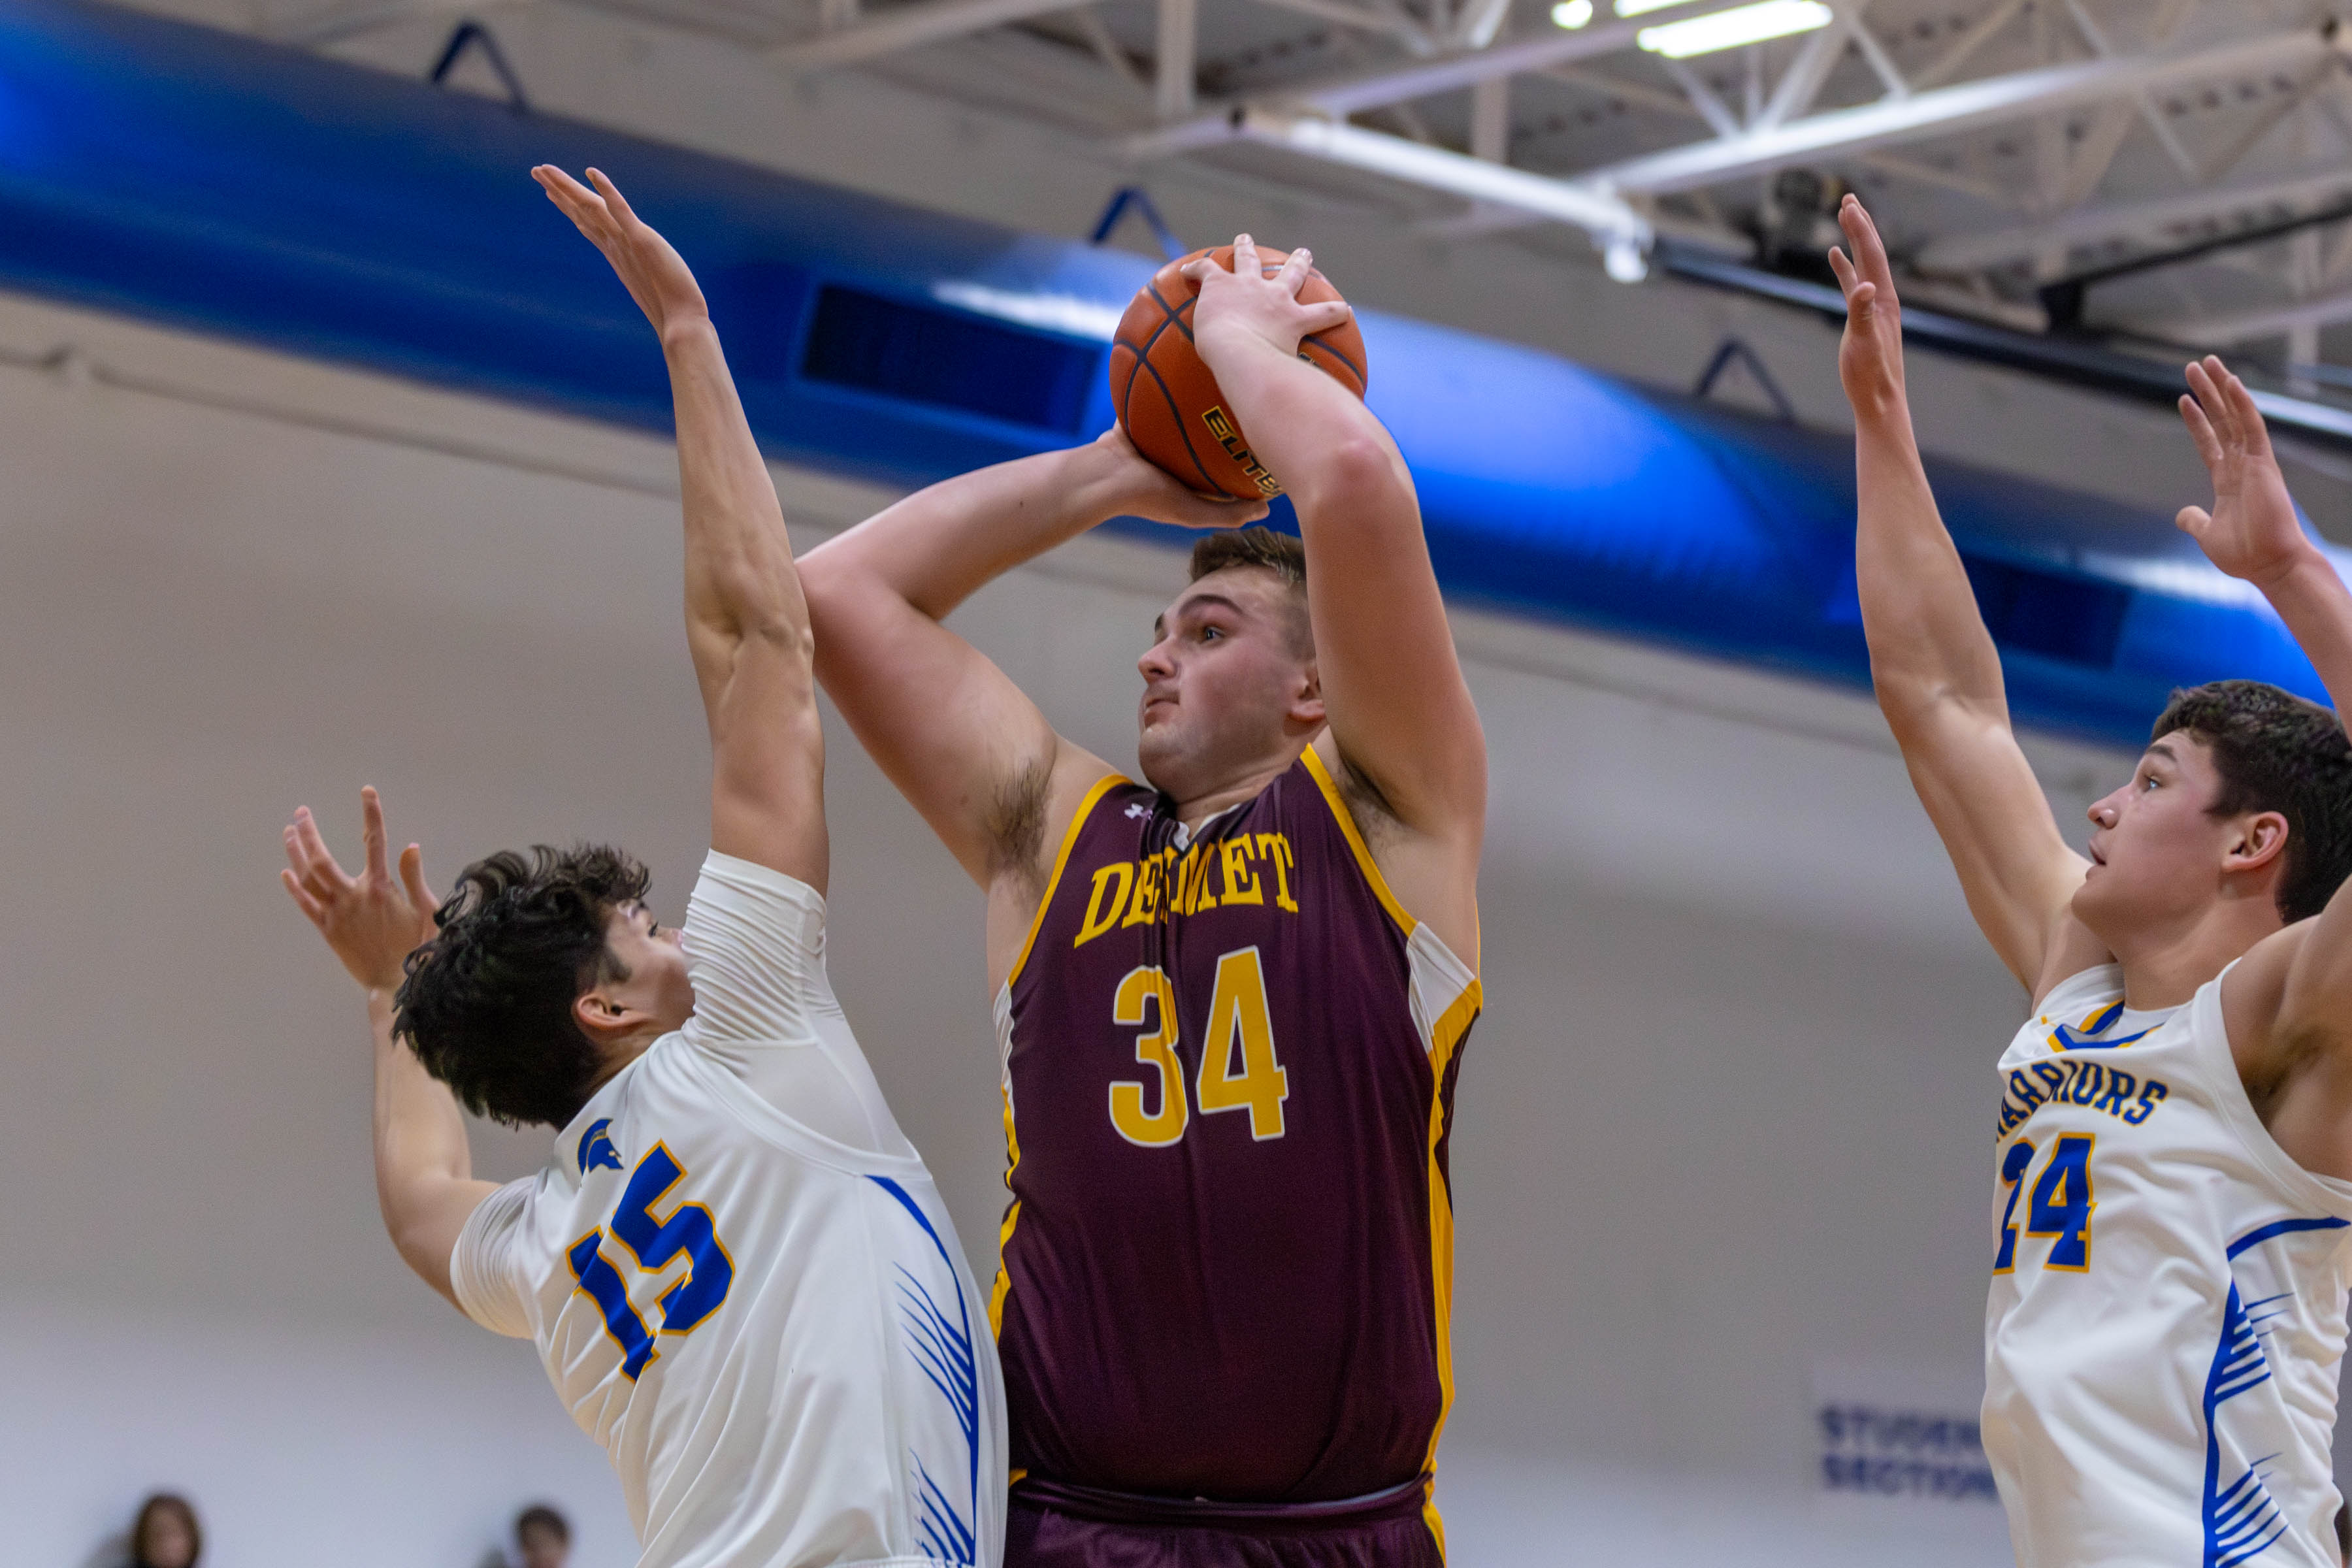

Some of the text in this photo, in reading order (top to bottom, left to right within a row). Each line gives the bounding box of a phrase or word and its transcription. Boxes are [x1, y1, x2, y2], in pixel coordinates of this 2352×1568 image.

[1109, 945, 1289, 1147] 34
[1997, 1058, 2169, 1143] ARRIORS
[565, 1138, 736, 1384] 15
